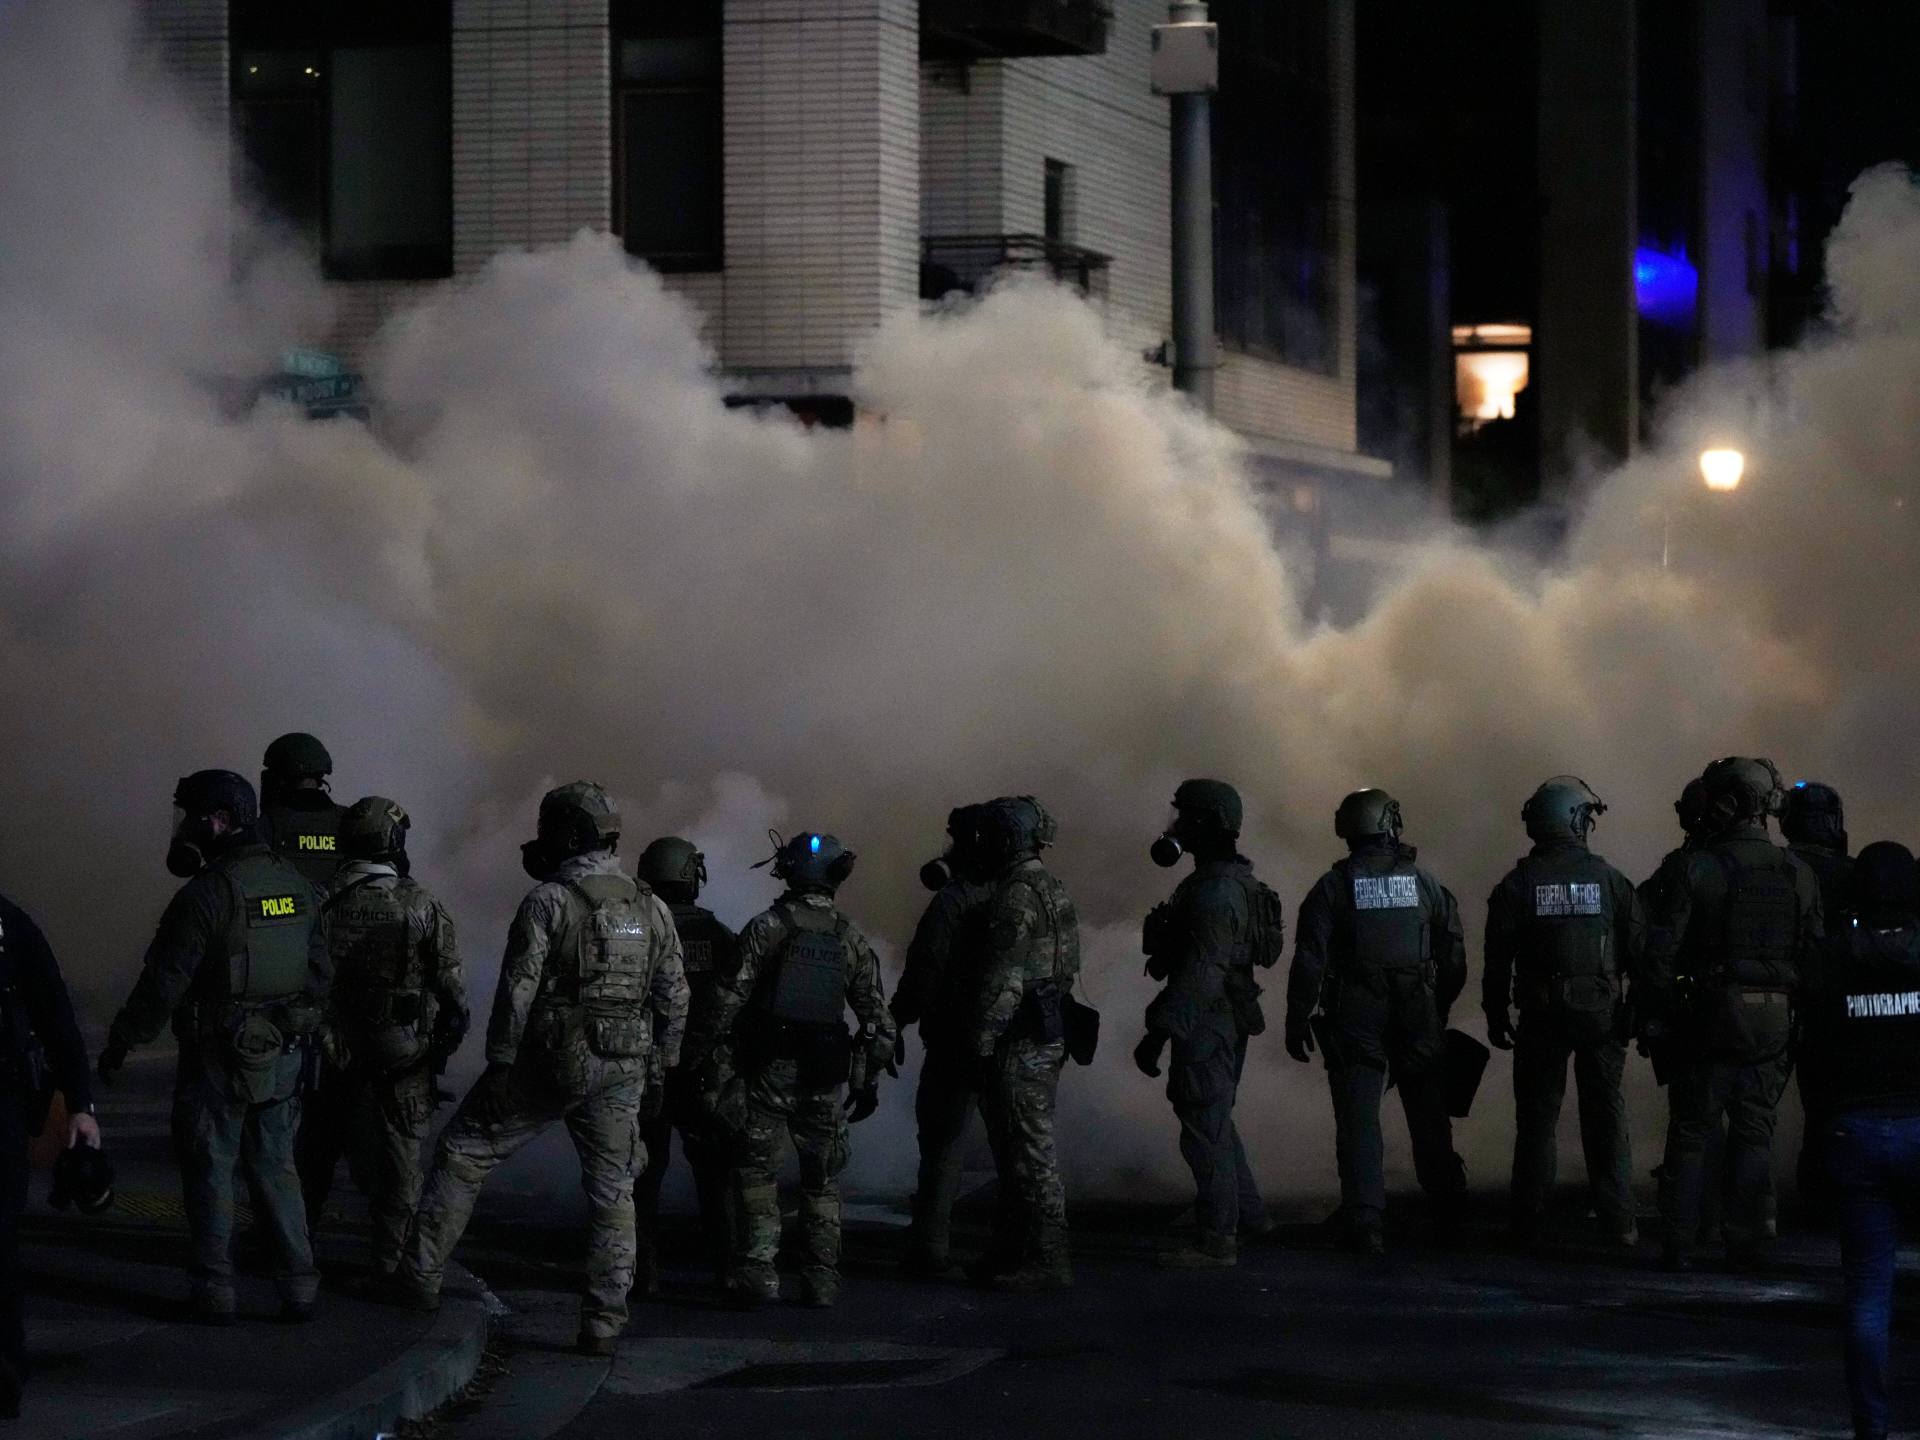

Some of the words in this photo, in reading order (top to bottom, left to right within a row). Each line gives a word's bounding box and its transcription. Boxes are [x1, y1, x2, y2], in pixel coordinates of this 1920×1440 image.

[298, 834, 336, 851] POLICE
[1355, 878, 1387, 898] FEDERAL
[1388, 876, 1417, 897] OFFICER
[1536, 885, 1569, 905] FEDERAL
[1570, 883, 1600, 904] OFFICER
[261, 897, 295, 917] POLICE
[1392, 896, 1418, 908] PRISONS
[1536, 905, 1562, 916] BUREAU
[1564, 905, 1573, 915] OF
[791, 944, 841, 964] POLICE
